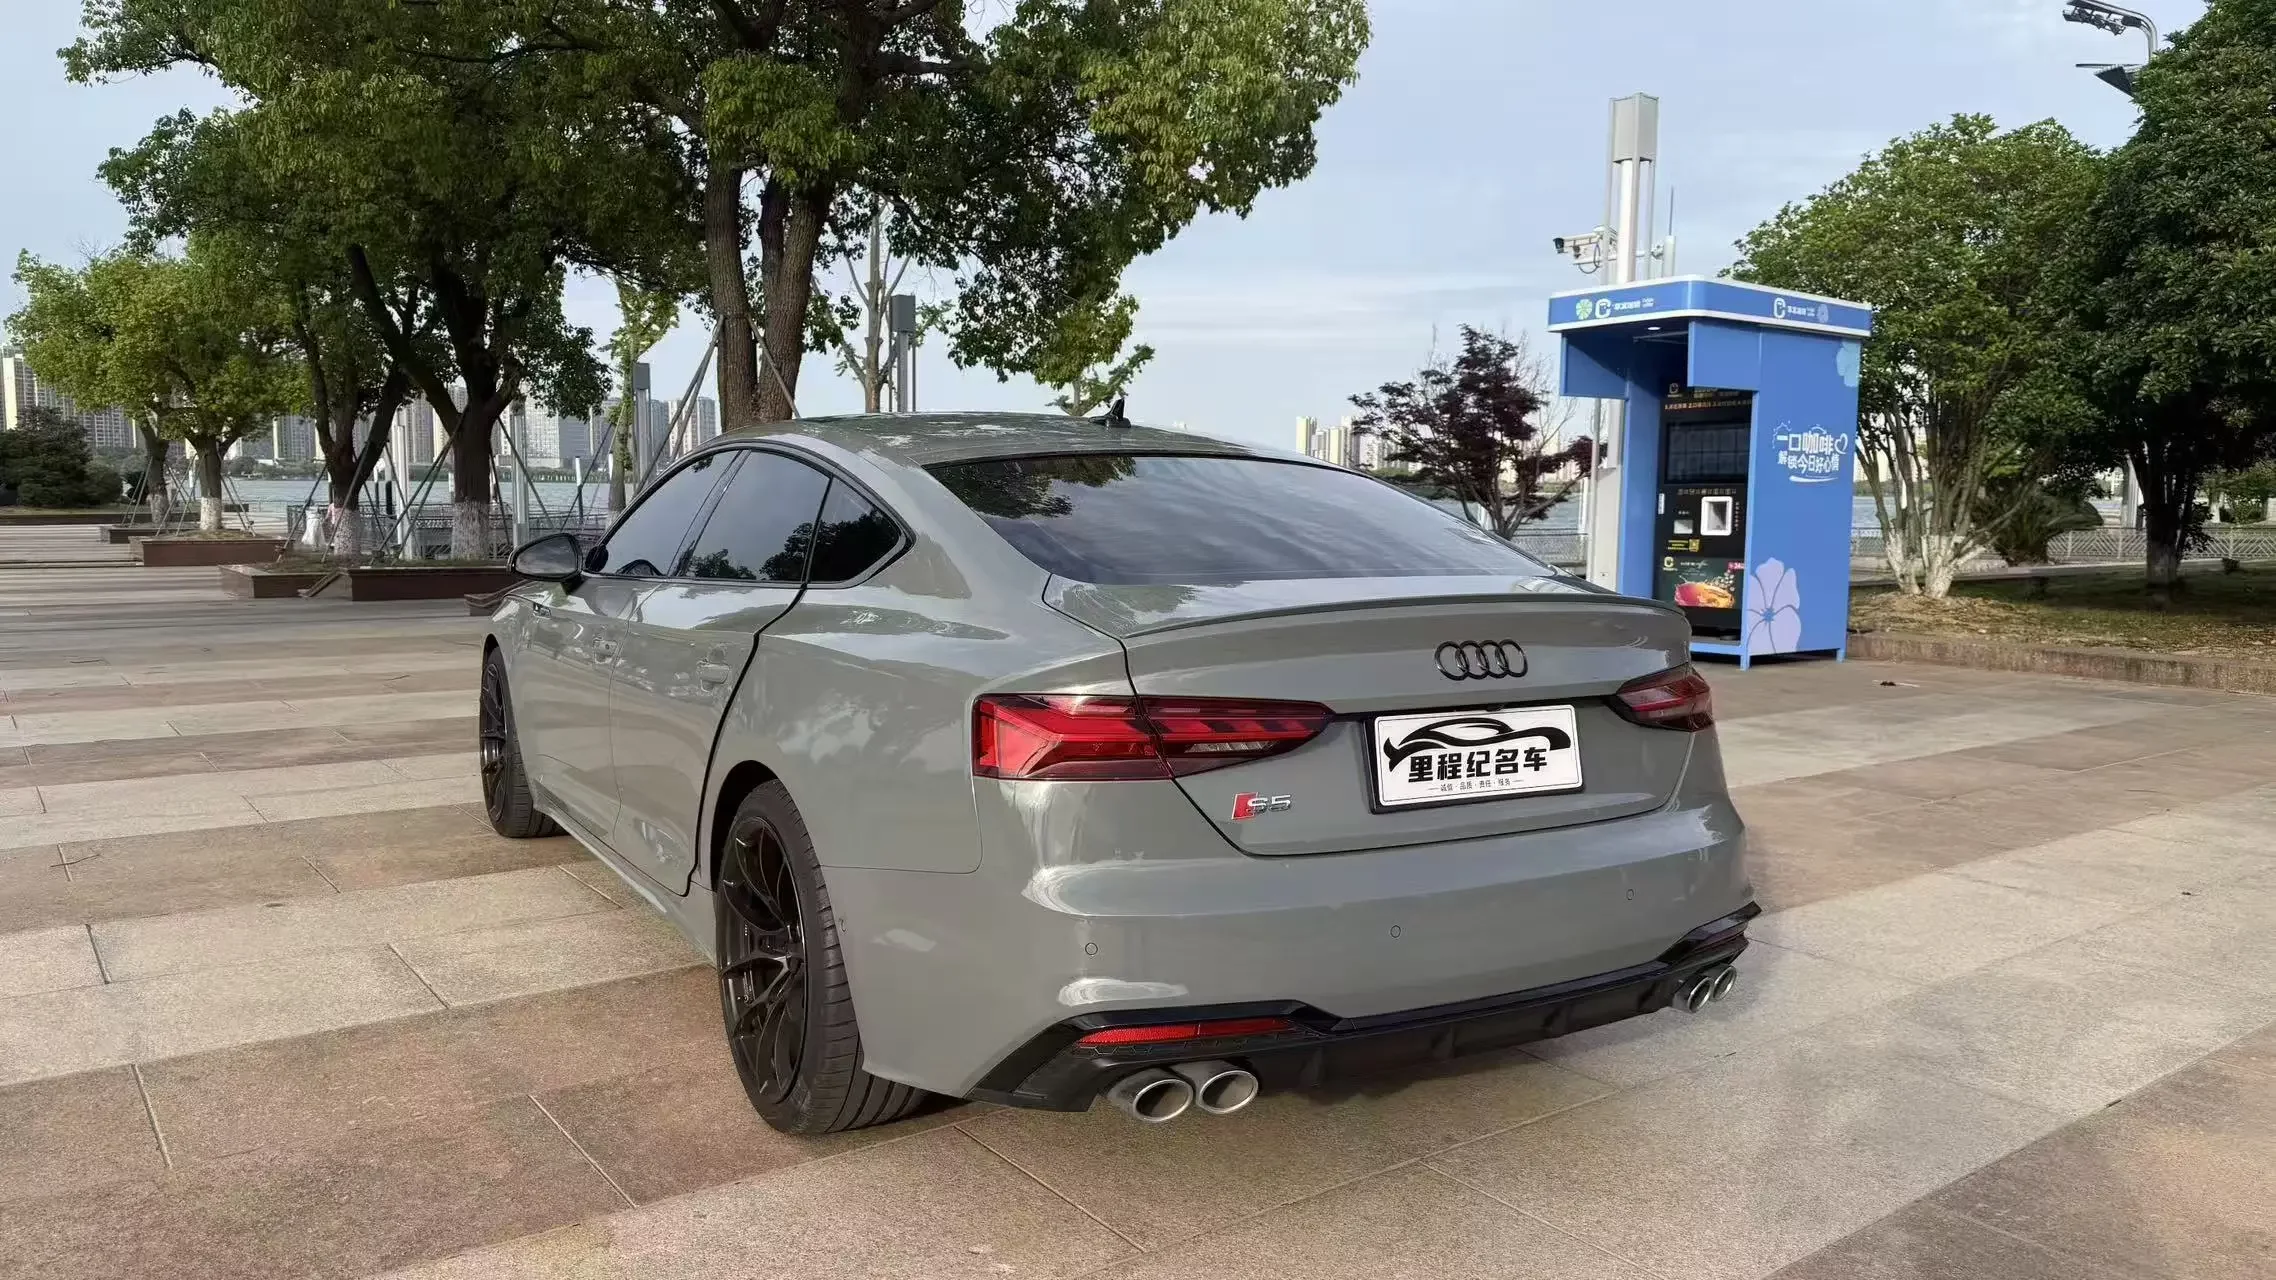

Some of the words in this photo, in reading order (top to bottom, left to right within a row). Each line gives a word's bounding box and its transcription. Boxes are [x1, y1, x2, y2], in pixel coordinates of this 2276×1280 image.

[1776, 431, 1835, 455] 一口咖啡
[1408, 747, 1548, 783] 里程纪名车
[1246, 794, 1291, 814] S5
